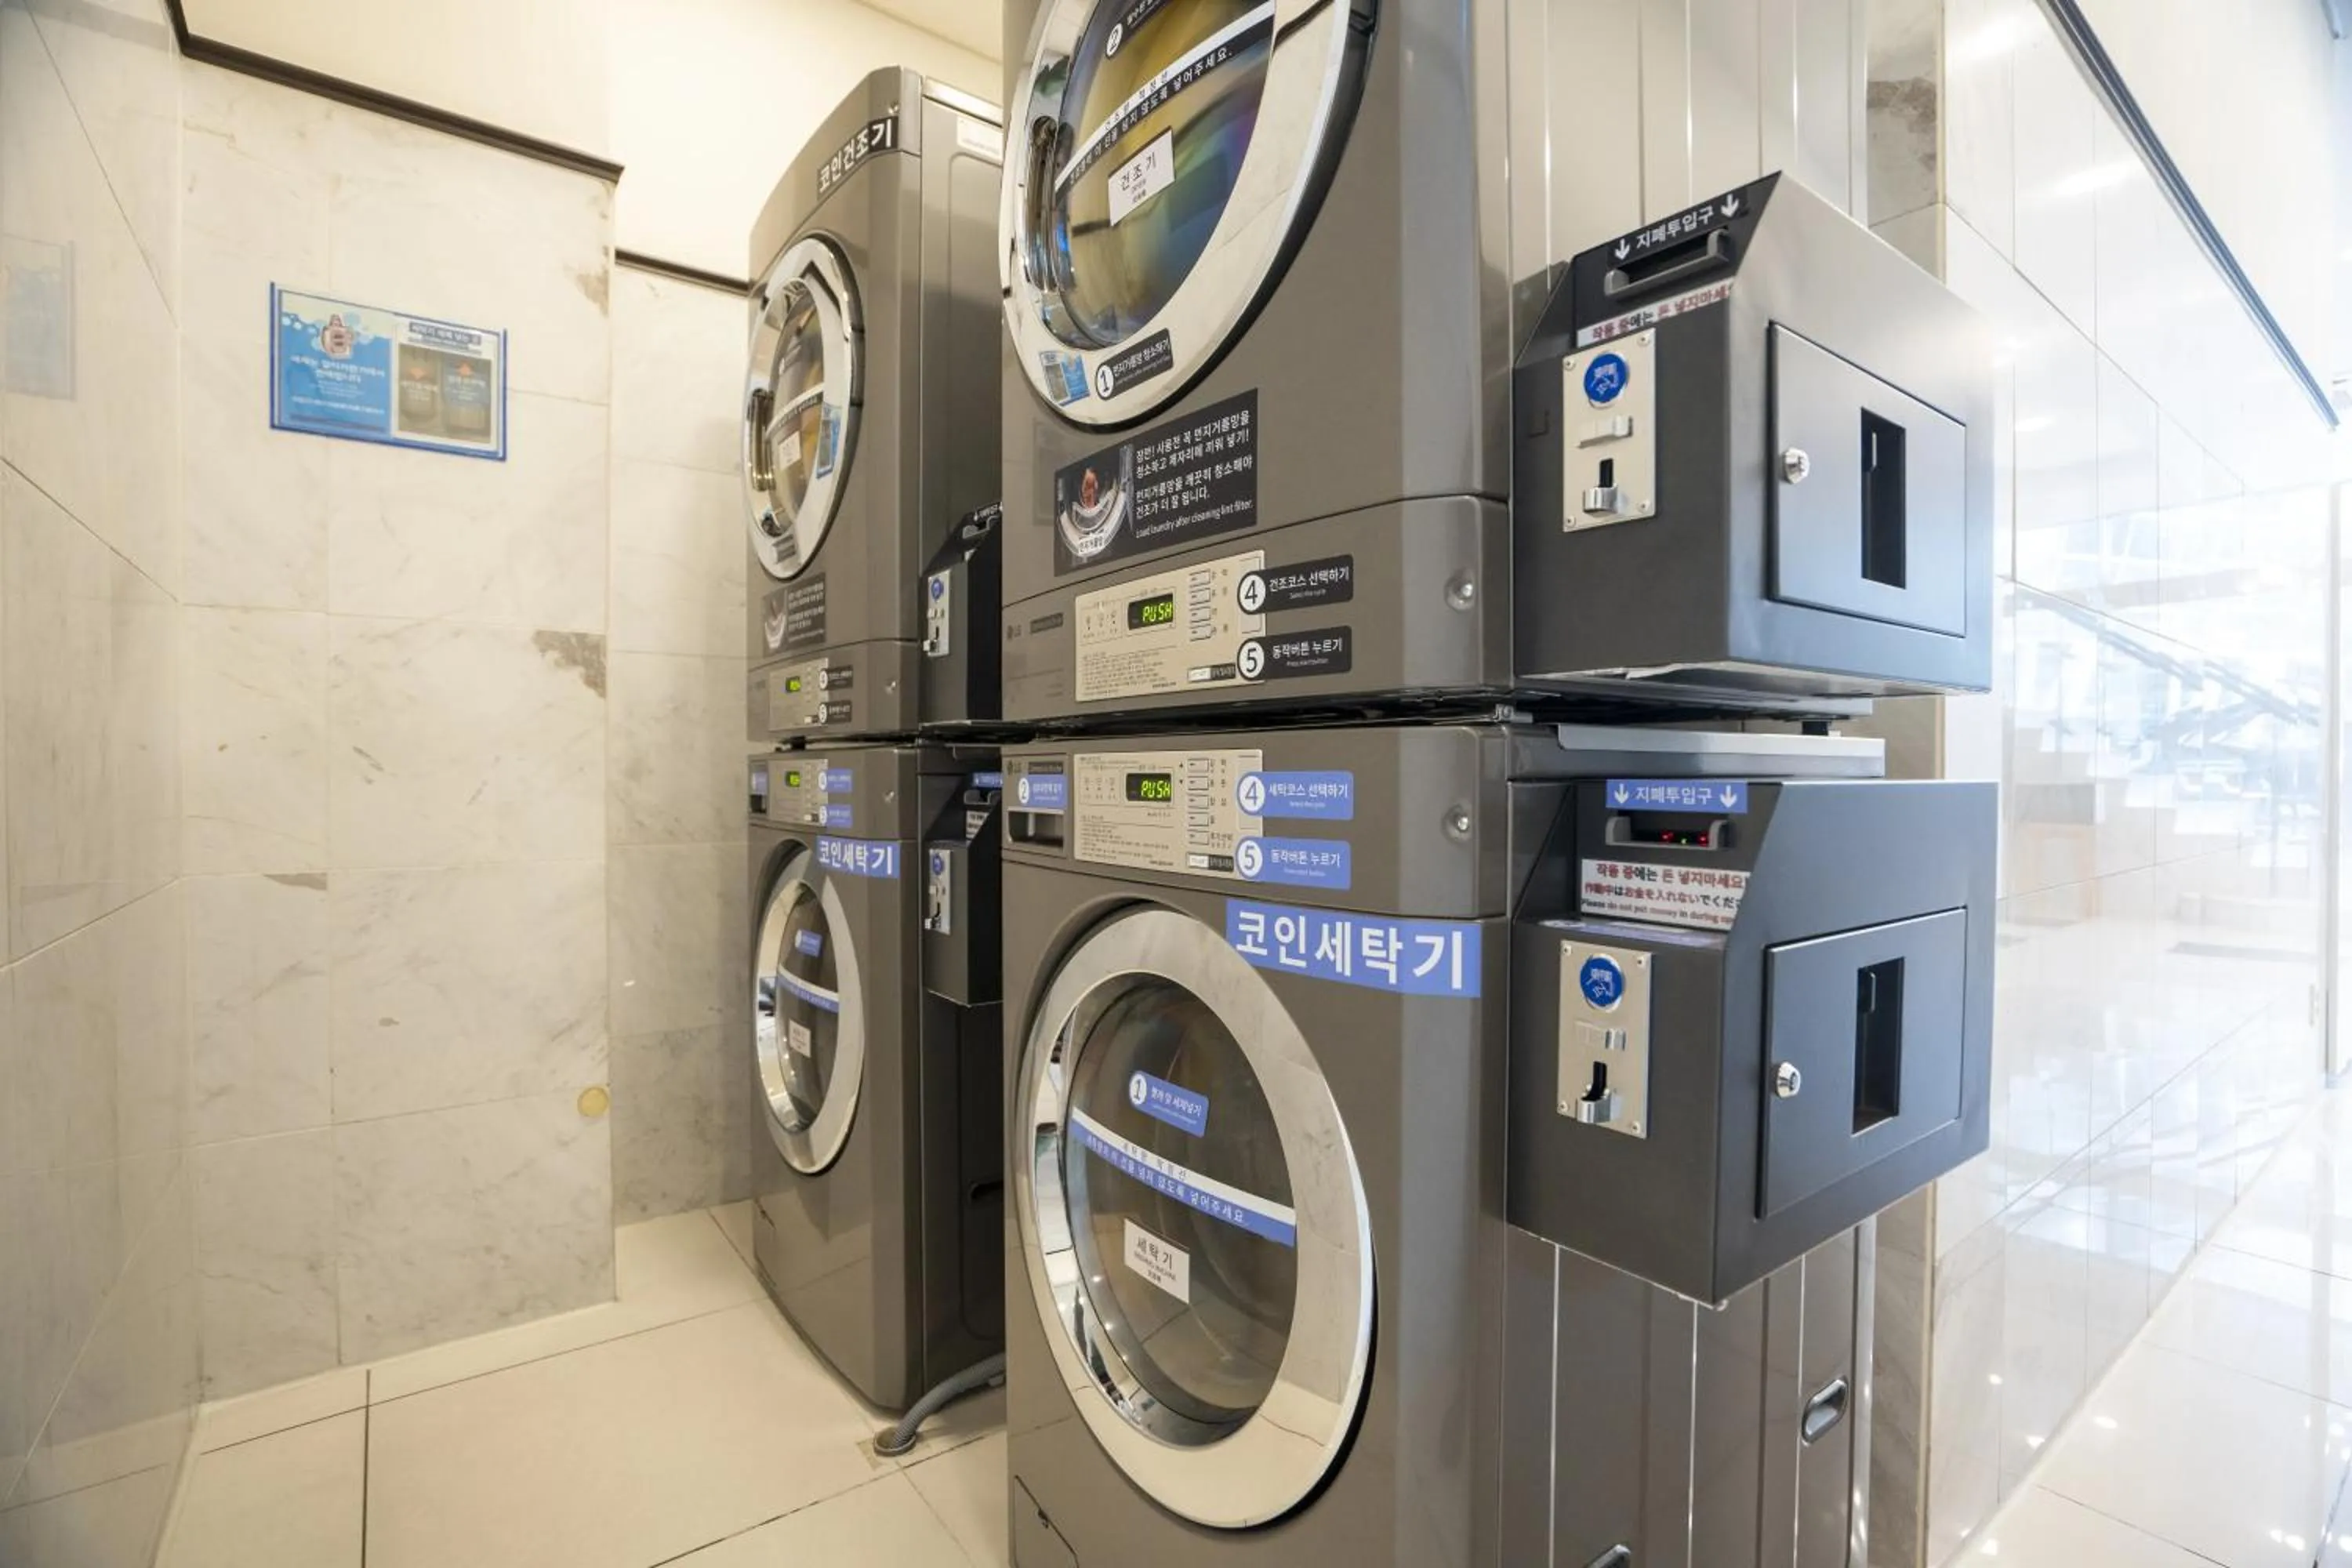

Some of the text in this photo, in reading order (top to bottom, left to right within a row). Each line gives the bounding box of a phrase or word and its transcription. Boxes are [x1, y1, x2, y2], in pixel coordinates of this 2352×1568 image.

[819, 118, 891, 193] 코인건조기
[1121, 151, 1157, 191] 건조기
[1636, 205, 1715, 249] 지폐투입구
[1675, 284, 1733, 311] 넣지마세
[1143, 337, 1170, 361] 청소하기
[1157, 435, 1181, 455] 사용전
[1194, 410, 1250, 441] 먼지거름망을
[1137, 457, 1167, 479] 청소하고
[1169, 443, 1203, 466] 제자리에
[1227, 427, 1249, 448] 넣기!
[1214, 454, 1253, 479] 청소해야
[1137, 501, 1158, 519] 건조가
[1161, 497, 1169, 510] 더
[1181, 485, 1210, 506] 됩니다.
[1269, 566, 1349, 592] 건조코스 선택하기
[1245, 580, 1258, 604] 4
[1142, 601, 1172, 622] PUSH
[1247, 648, 1258, 673] 5
[1272, 637, 1342, 659] 동작버튼 누르기
[1142, 779, 1171, 799] PUSH
[1245, 781, 1258, 807] 4
[1269, 782, 1348, 798] 세탁코스 선택하기
[1635, 786, 1714, 804] 지폐투입구
[818, 840, 892, 874] 코인세탁기
[1244, 845, 1256, 869] 5
[1271, 848, 1341, 869] 동작버튼 누르기
[1596, 863, 1744, 888] 작동 중에는 돈 넣지마세요
[1236, 910, 1462, 990] 코인세탁기
[1138, 1236, 1172, 1270] 세탁기
